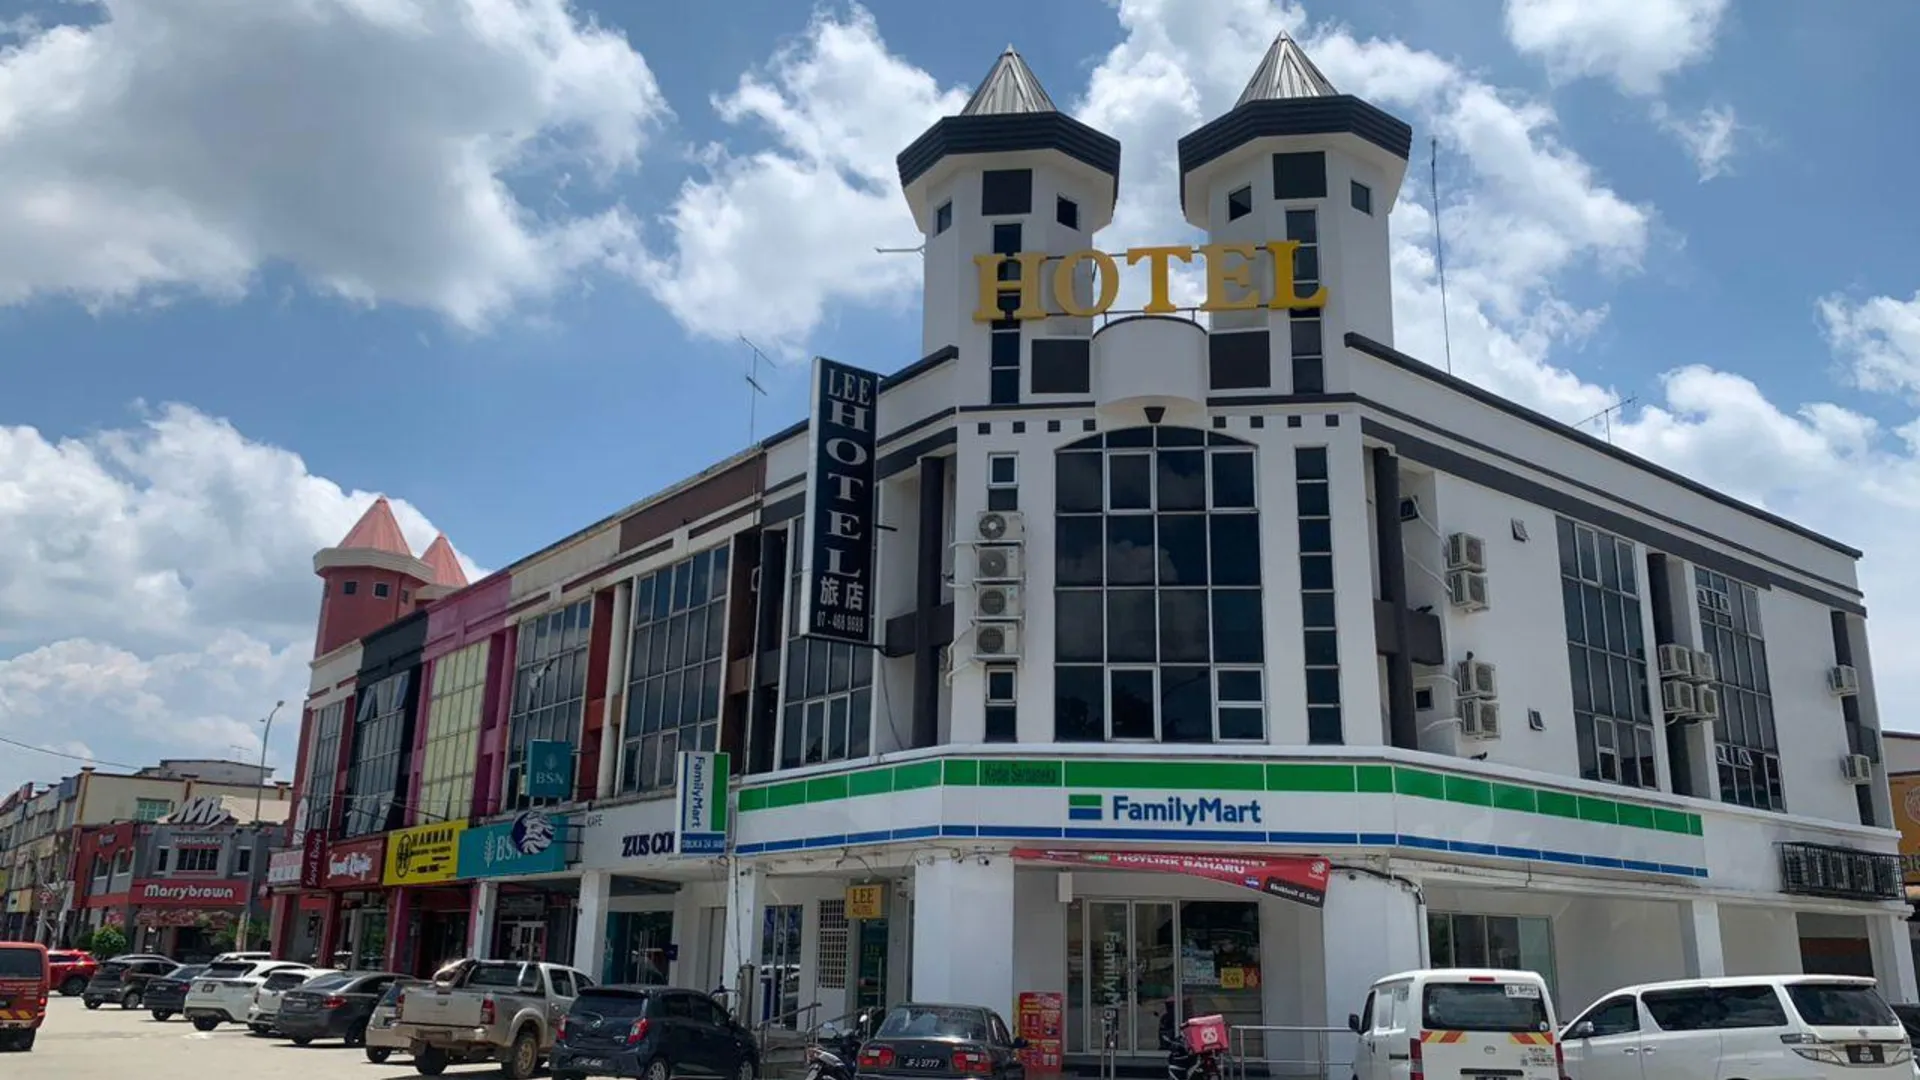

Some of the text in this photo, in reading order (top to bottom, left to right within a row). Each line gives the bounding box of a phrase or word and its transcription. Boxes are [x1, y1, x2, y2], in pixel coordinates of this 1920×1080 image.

[972, 240, 1328, 322] HOTEL
[827, 367, 871, 405] LEE
[826, 399, 868, 578] HOTEL
[820, 576, 864, 611] 旅店
[536, 771, 565, 785] BSN
[691, 756, 705, 829] FamilyMart
[1113, 795, 1262, 826] FamilyMart
[622, 834, 650, 857] ZUS
[1116, 855, 1180, 866] HOTLINK
[1183, 860, 1246, 874] BAHARU
[144, 884, 234, 900] Marrybrown
[852, 887, 874, 904] LEE
